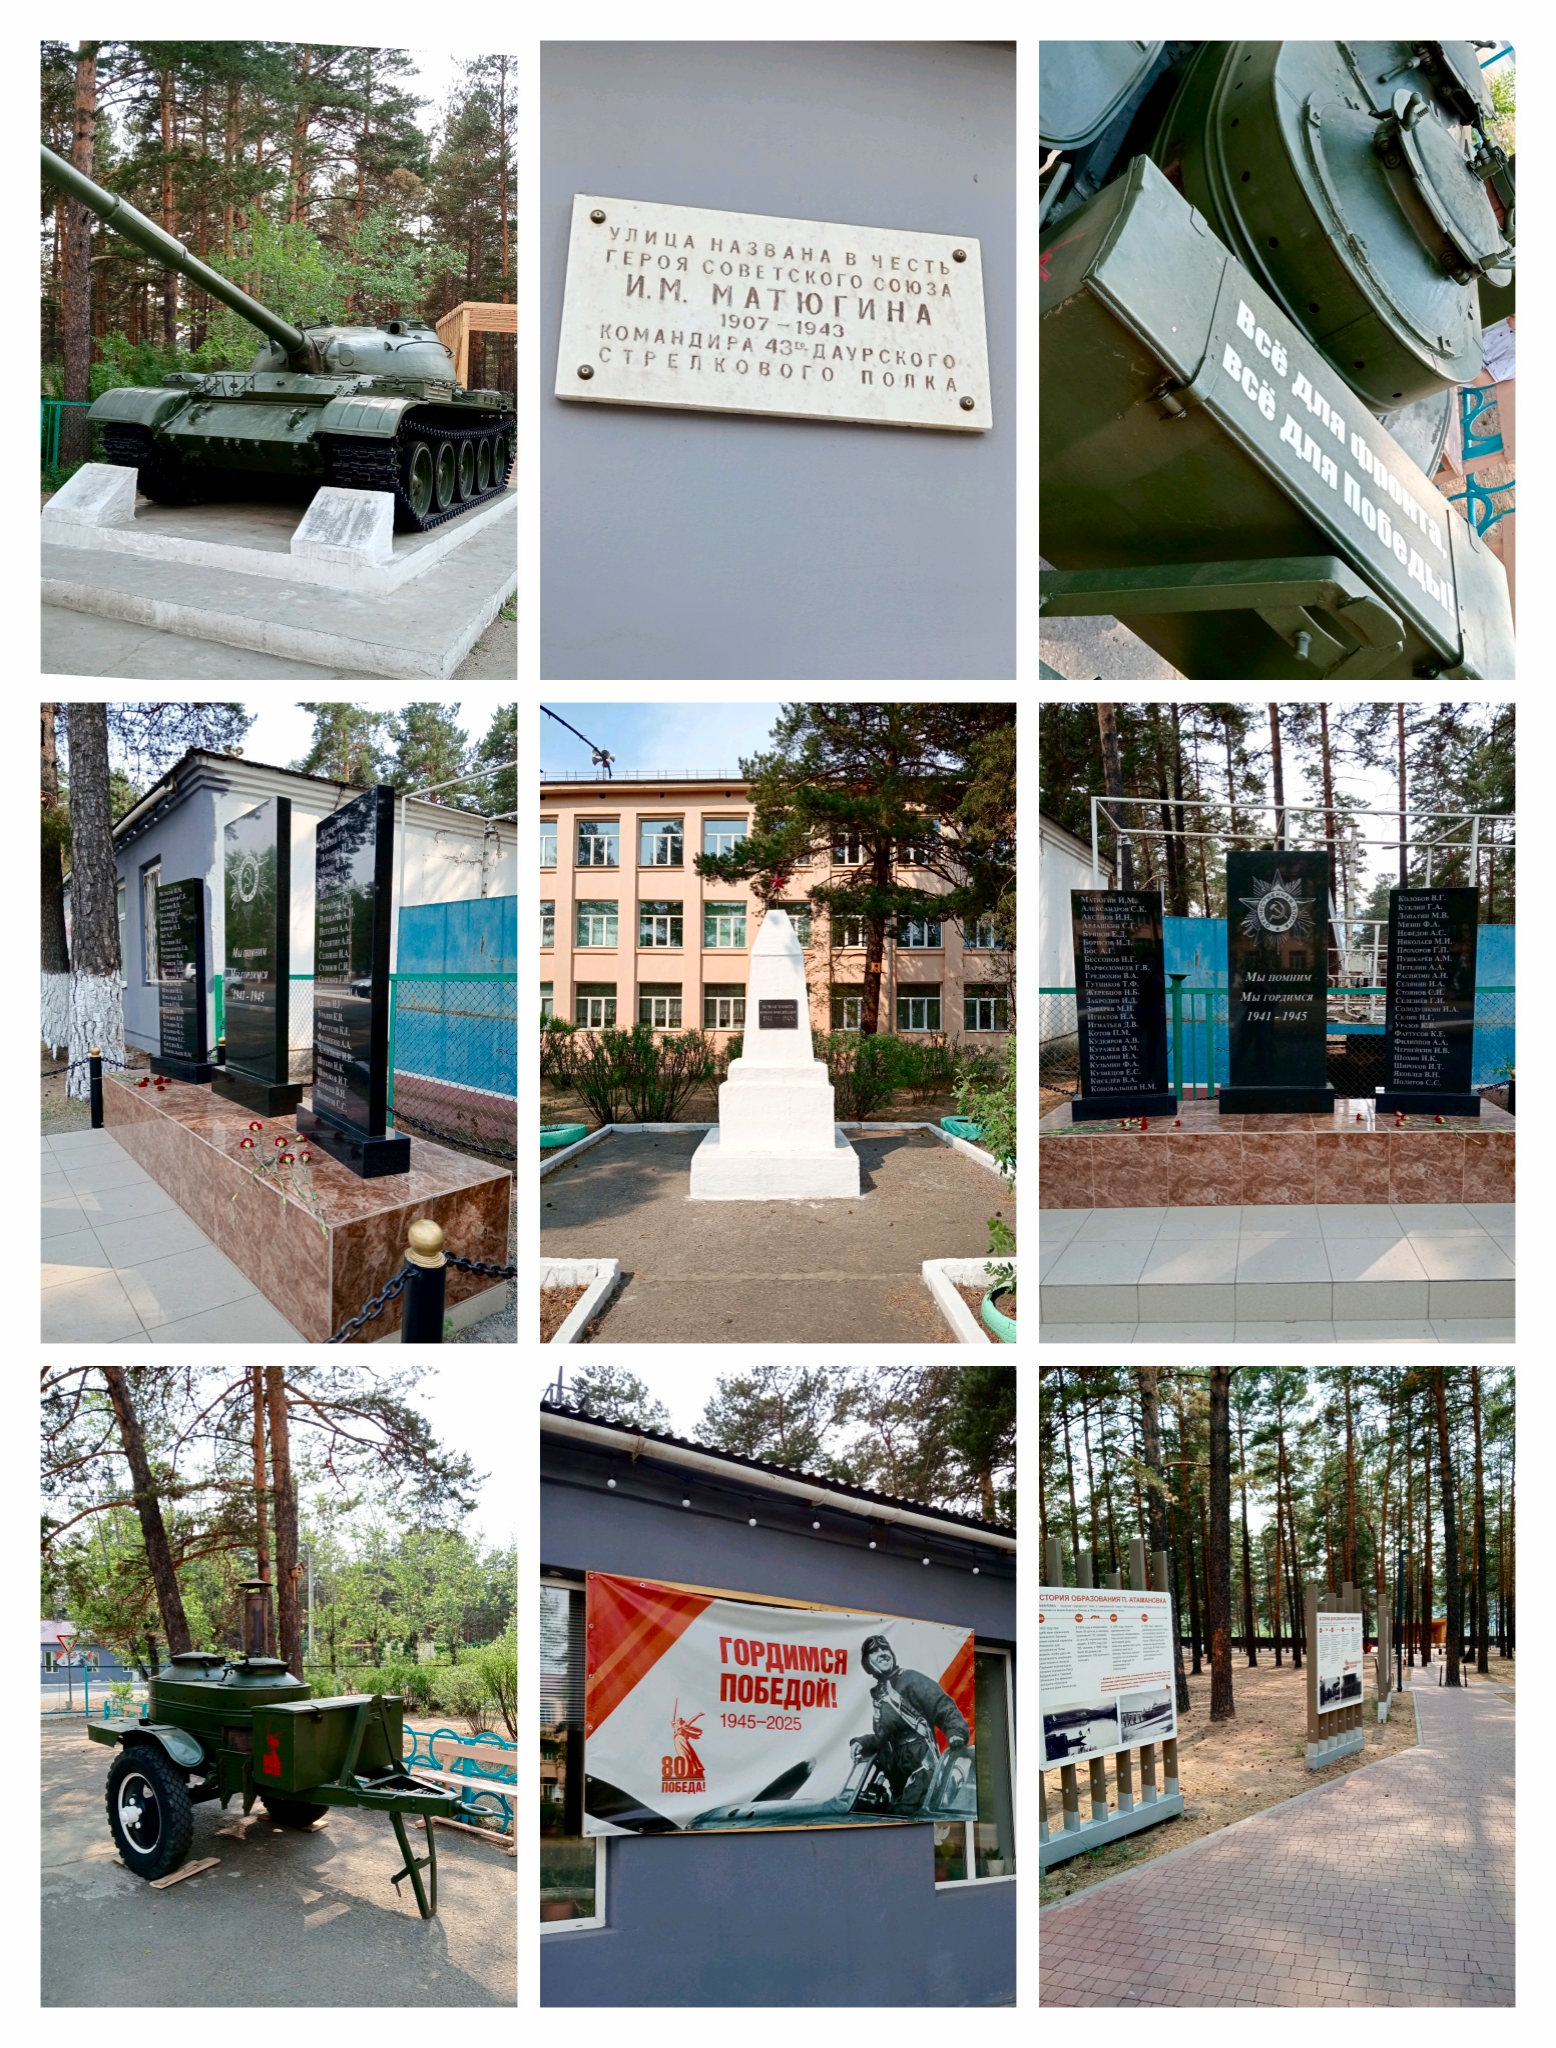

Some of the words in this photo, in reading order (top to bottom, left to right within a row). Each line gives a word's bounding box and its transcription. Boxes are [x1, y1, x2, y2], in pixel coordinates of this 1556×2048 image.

[610, 226, 694, 248] УЛИЦА
[710, 238, 830, 263] НАЗВАНА
[846, 252, 856, 266] В
[872, 254, 950, 275] ЧЕСТЬ
[606, 250, 688, 272] ГЕРОЯ
[702, 260, 862, 289] СОВЕТСКОГО
[874, 276, 952, 298] СОЮЗА
[626, 274, 688, 303] И.М.
[712, 283, 932, 326] МАТЮГИНА
[600, 324, 754, 352] КОМАНДИРА
[812, 343, 956, 370] ДАУРСКОГО
[720, 314, 769, 330] 1907
[796, 320, 844, 338] 1943
[599, 347, 834, 382] СТРЕЛКОВОГО
[861, 370, 957, 392] ПОЛКА
[1236, 298, 1288, 377] Всё
[1291, 370, 1346, 445] для
[1350, 434, 1447, 559] фронта,
[1280, 412, 1338, 491] для
[1344, 470, 1456, 619] Победы!
[1247, 1012, 1271, 1021] 1941
[1283, 1012, 1308, 1021] 1945
[1039, 1594, 1070, 1602] СТОРИЯ
[1071, 1594, 1121, 1602] ОБРАЗОВАНИЯ
[719, 1636, 848, 1675] ГОРДИМСЯ
[720, 1672, 838, 1711] ПОБЕДОЙ!
[661, 1781, 706, 1794] ПОБЕДА!
[662, 1756, 688, 1778] 80
